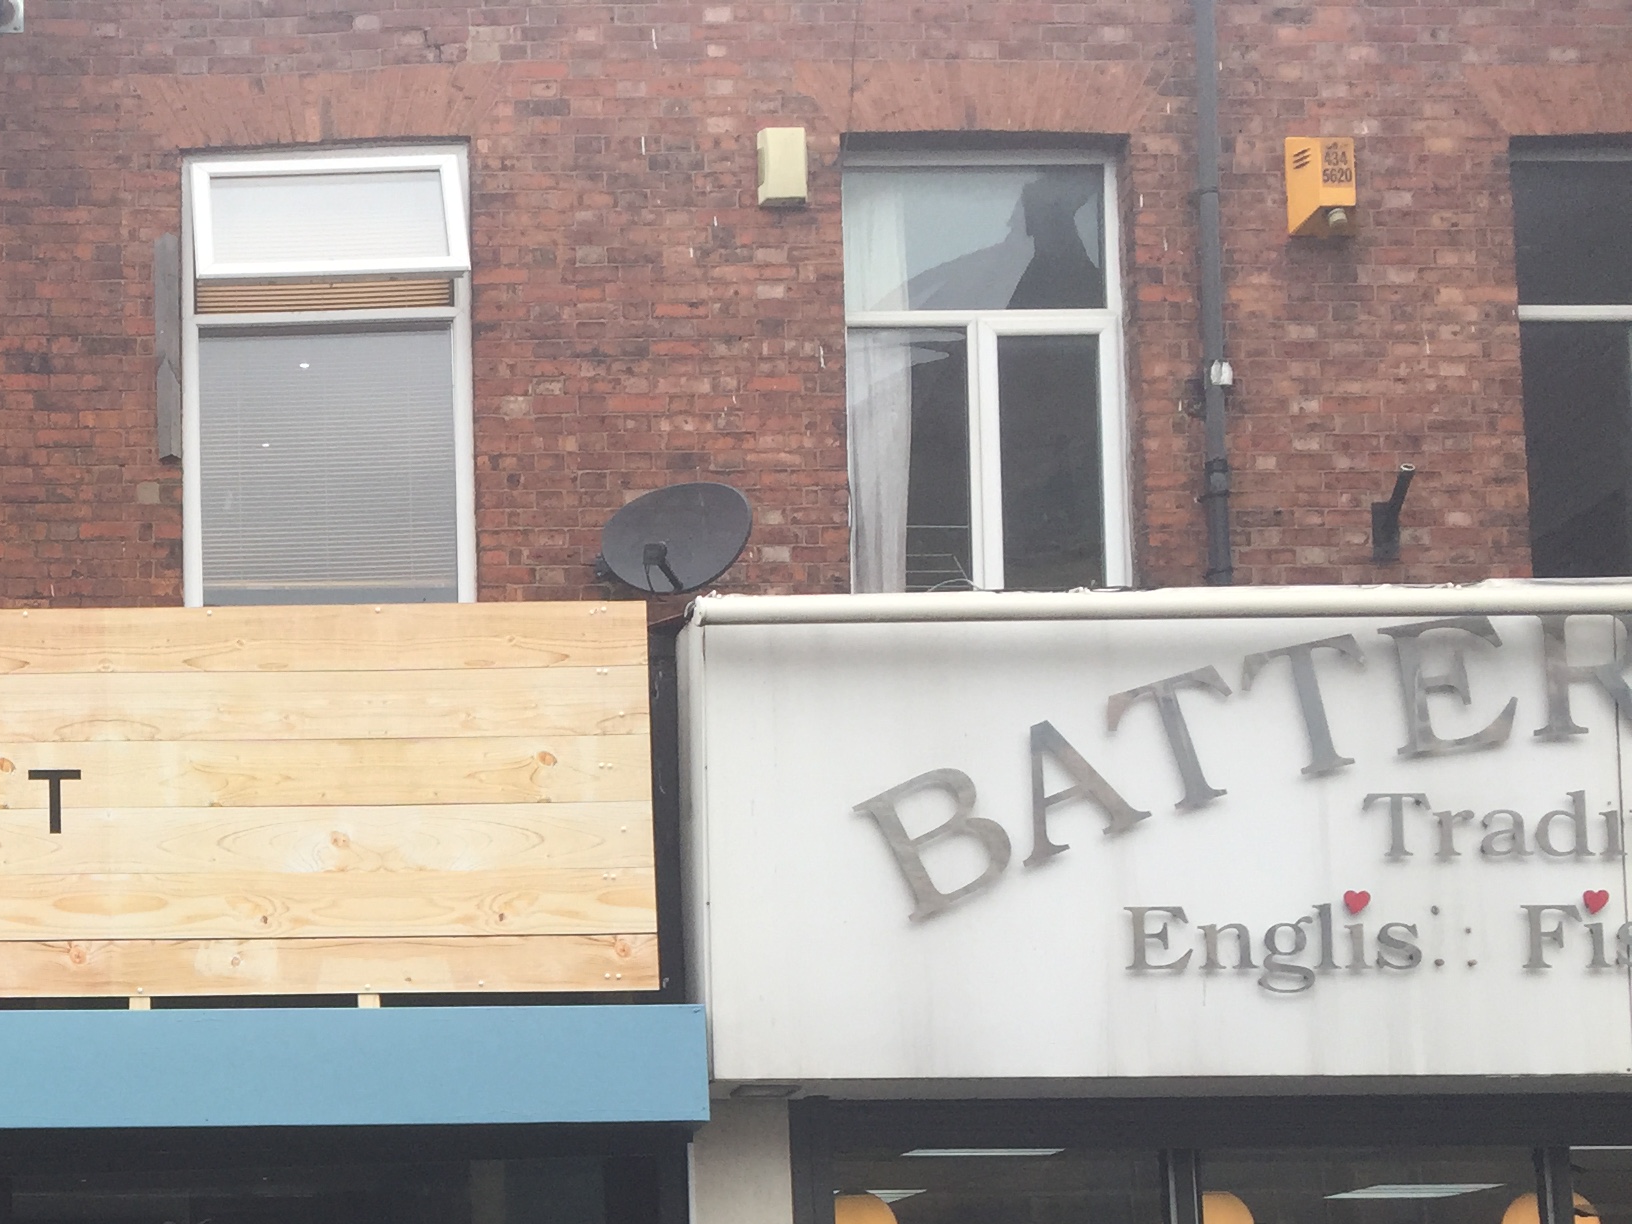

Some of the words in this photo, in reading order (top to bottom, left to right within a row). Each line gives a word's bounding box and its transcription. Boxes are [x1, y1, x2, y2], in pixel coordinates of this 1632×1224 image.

[1322, 167, 1353, 183] 5620
[1324, 151, 1348, 167] 434
[852, 615, 1632, 923] BATTER
[1361, 790, 1632, 858] Tradi
